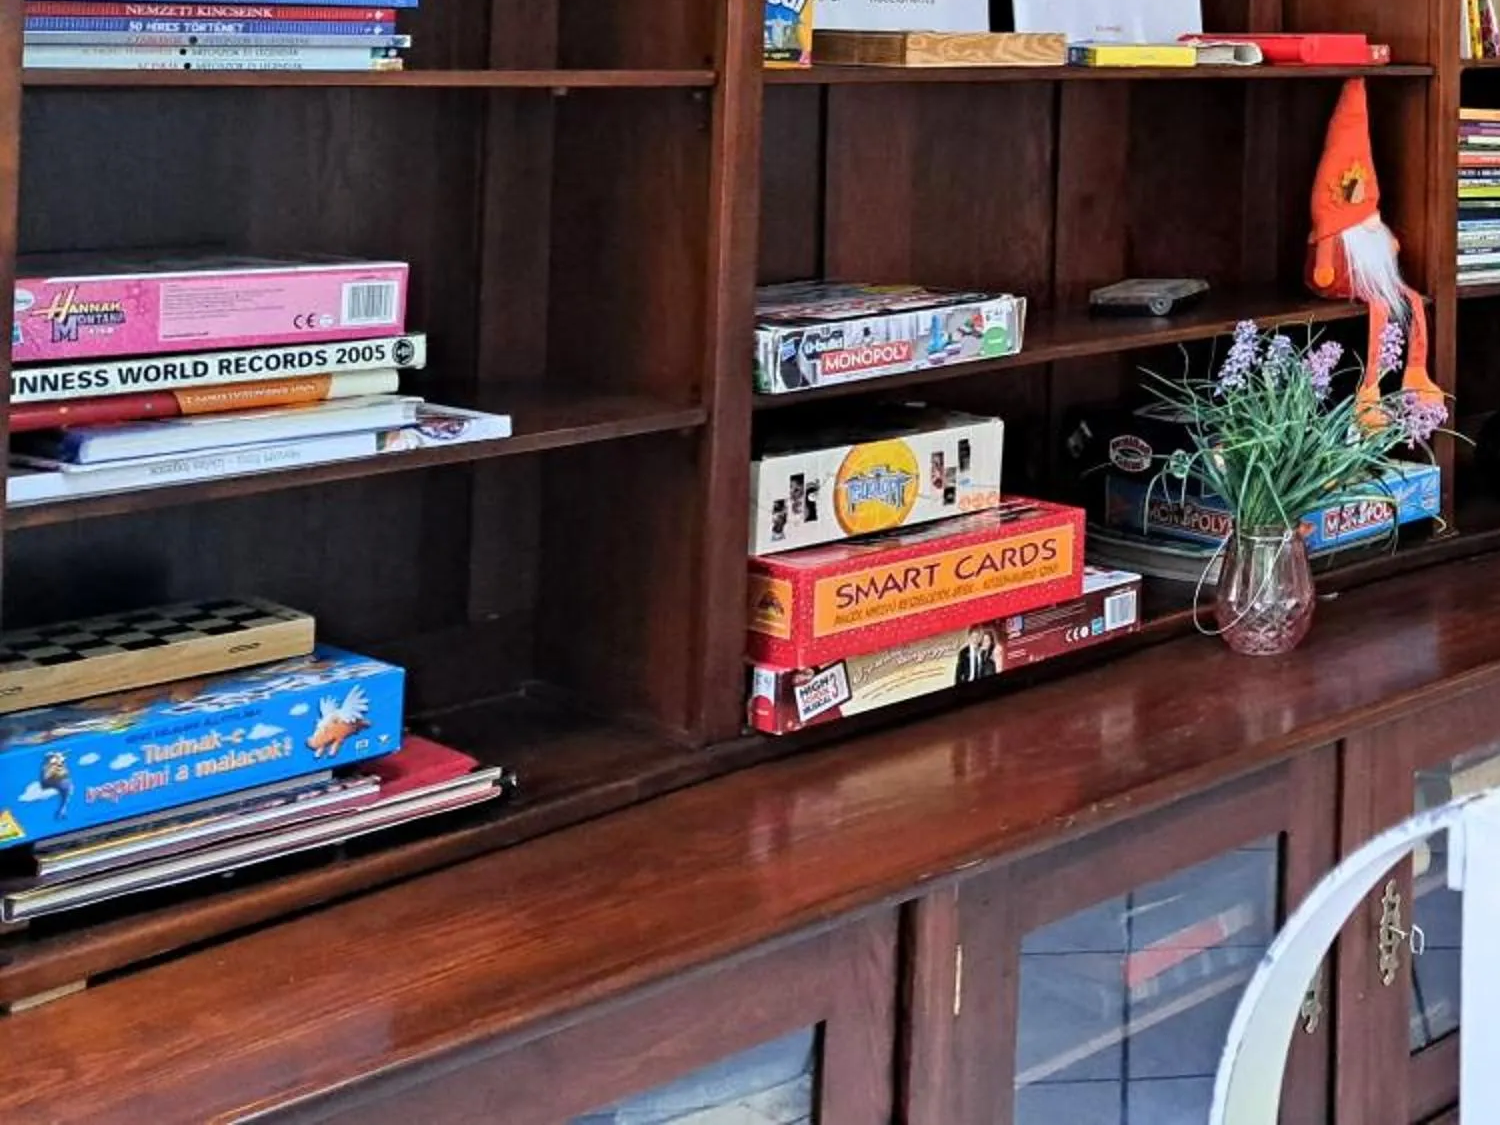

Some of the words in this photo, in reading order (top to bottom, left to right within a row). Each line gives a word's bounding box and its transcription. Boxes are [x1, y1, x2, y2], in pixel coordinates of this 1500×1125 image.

[126, 4, 193, 17] NEMZETI
[47, 284, 122, 323] HANNAH
[52, 310, 126, 342] MONTANA
[118, 361, 209, 385] WORLD
[219, 350, 328, 377] RECORDS
[335, 344, 386, 365] 2005
[823, 344, 911, 374] MONOPOLY
[834, 562, 942, 609] SMART
[954, 538, 1057, 580] CARDS
[174, 763, 190, 782] a
